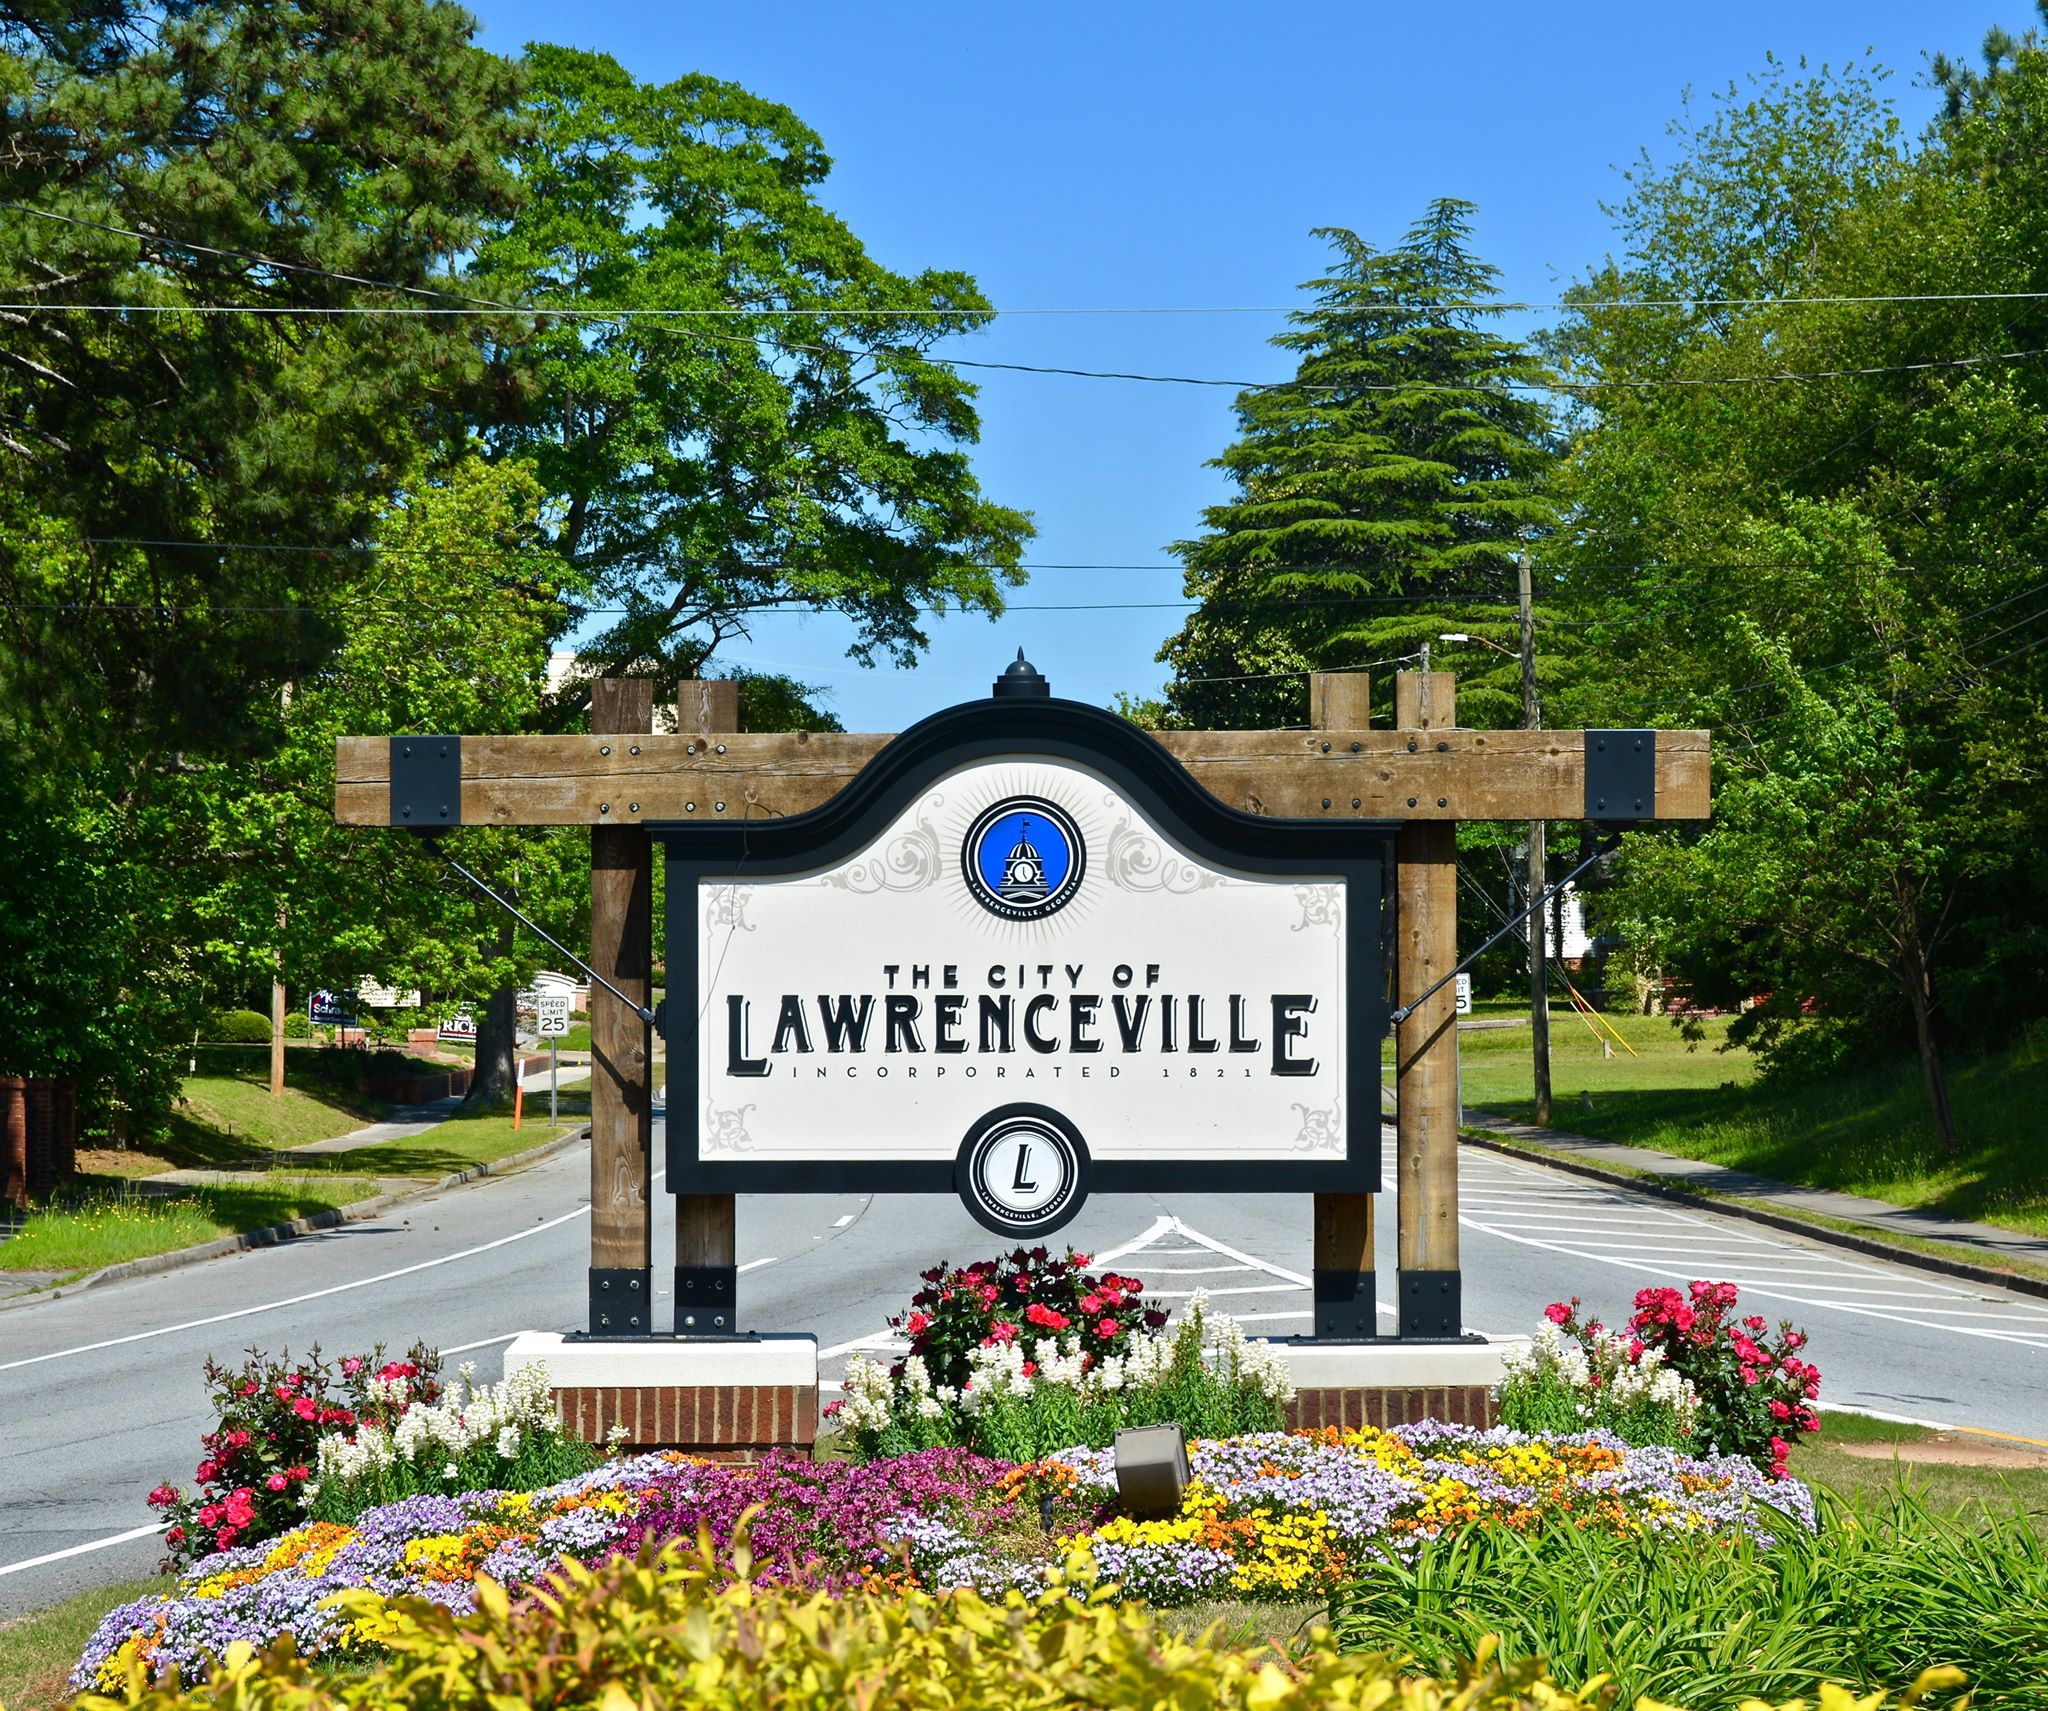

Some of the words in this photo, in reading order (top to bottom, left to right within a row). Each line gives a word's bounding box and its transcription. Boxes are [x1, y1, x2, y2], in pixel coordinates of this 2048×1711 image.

[1045, 881, 1077, 911] GEORGIA
[883, 964, 958, 990] THE
[987, 963, 1084, 990] CITY
[1112, 963, 1160, 989] OF
[540, 1000, 566, 1008] SPEED
[541, 1017, 565, 1032] 25
[726, 994, 1320, 1078] LAWRENCEVILLE
[792, 1066, 1121, 1079] INCORPORATED
[1162, 1066, 1252, 1079] 1821
[1011, 1143, 1040, 1194] L
[1041, 1189, 1067, 1216] GEORGIA
